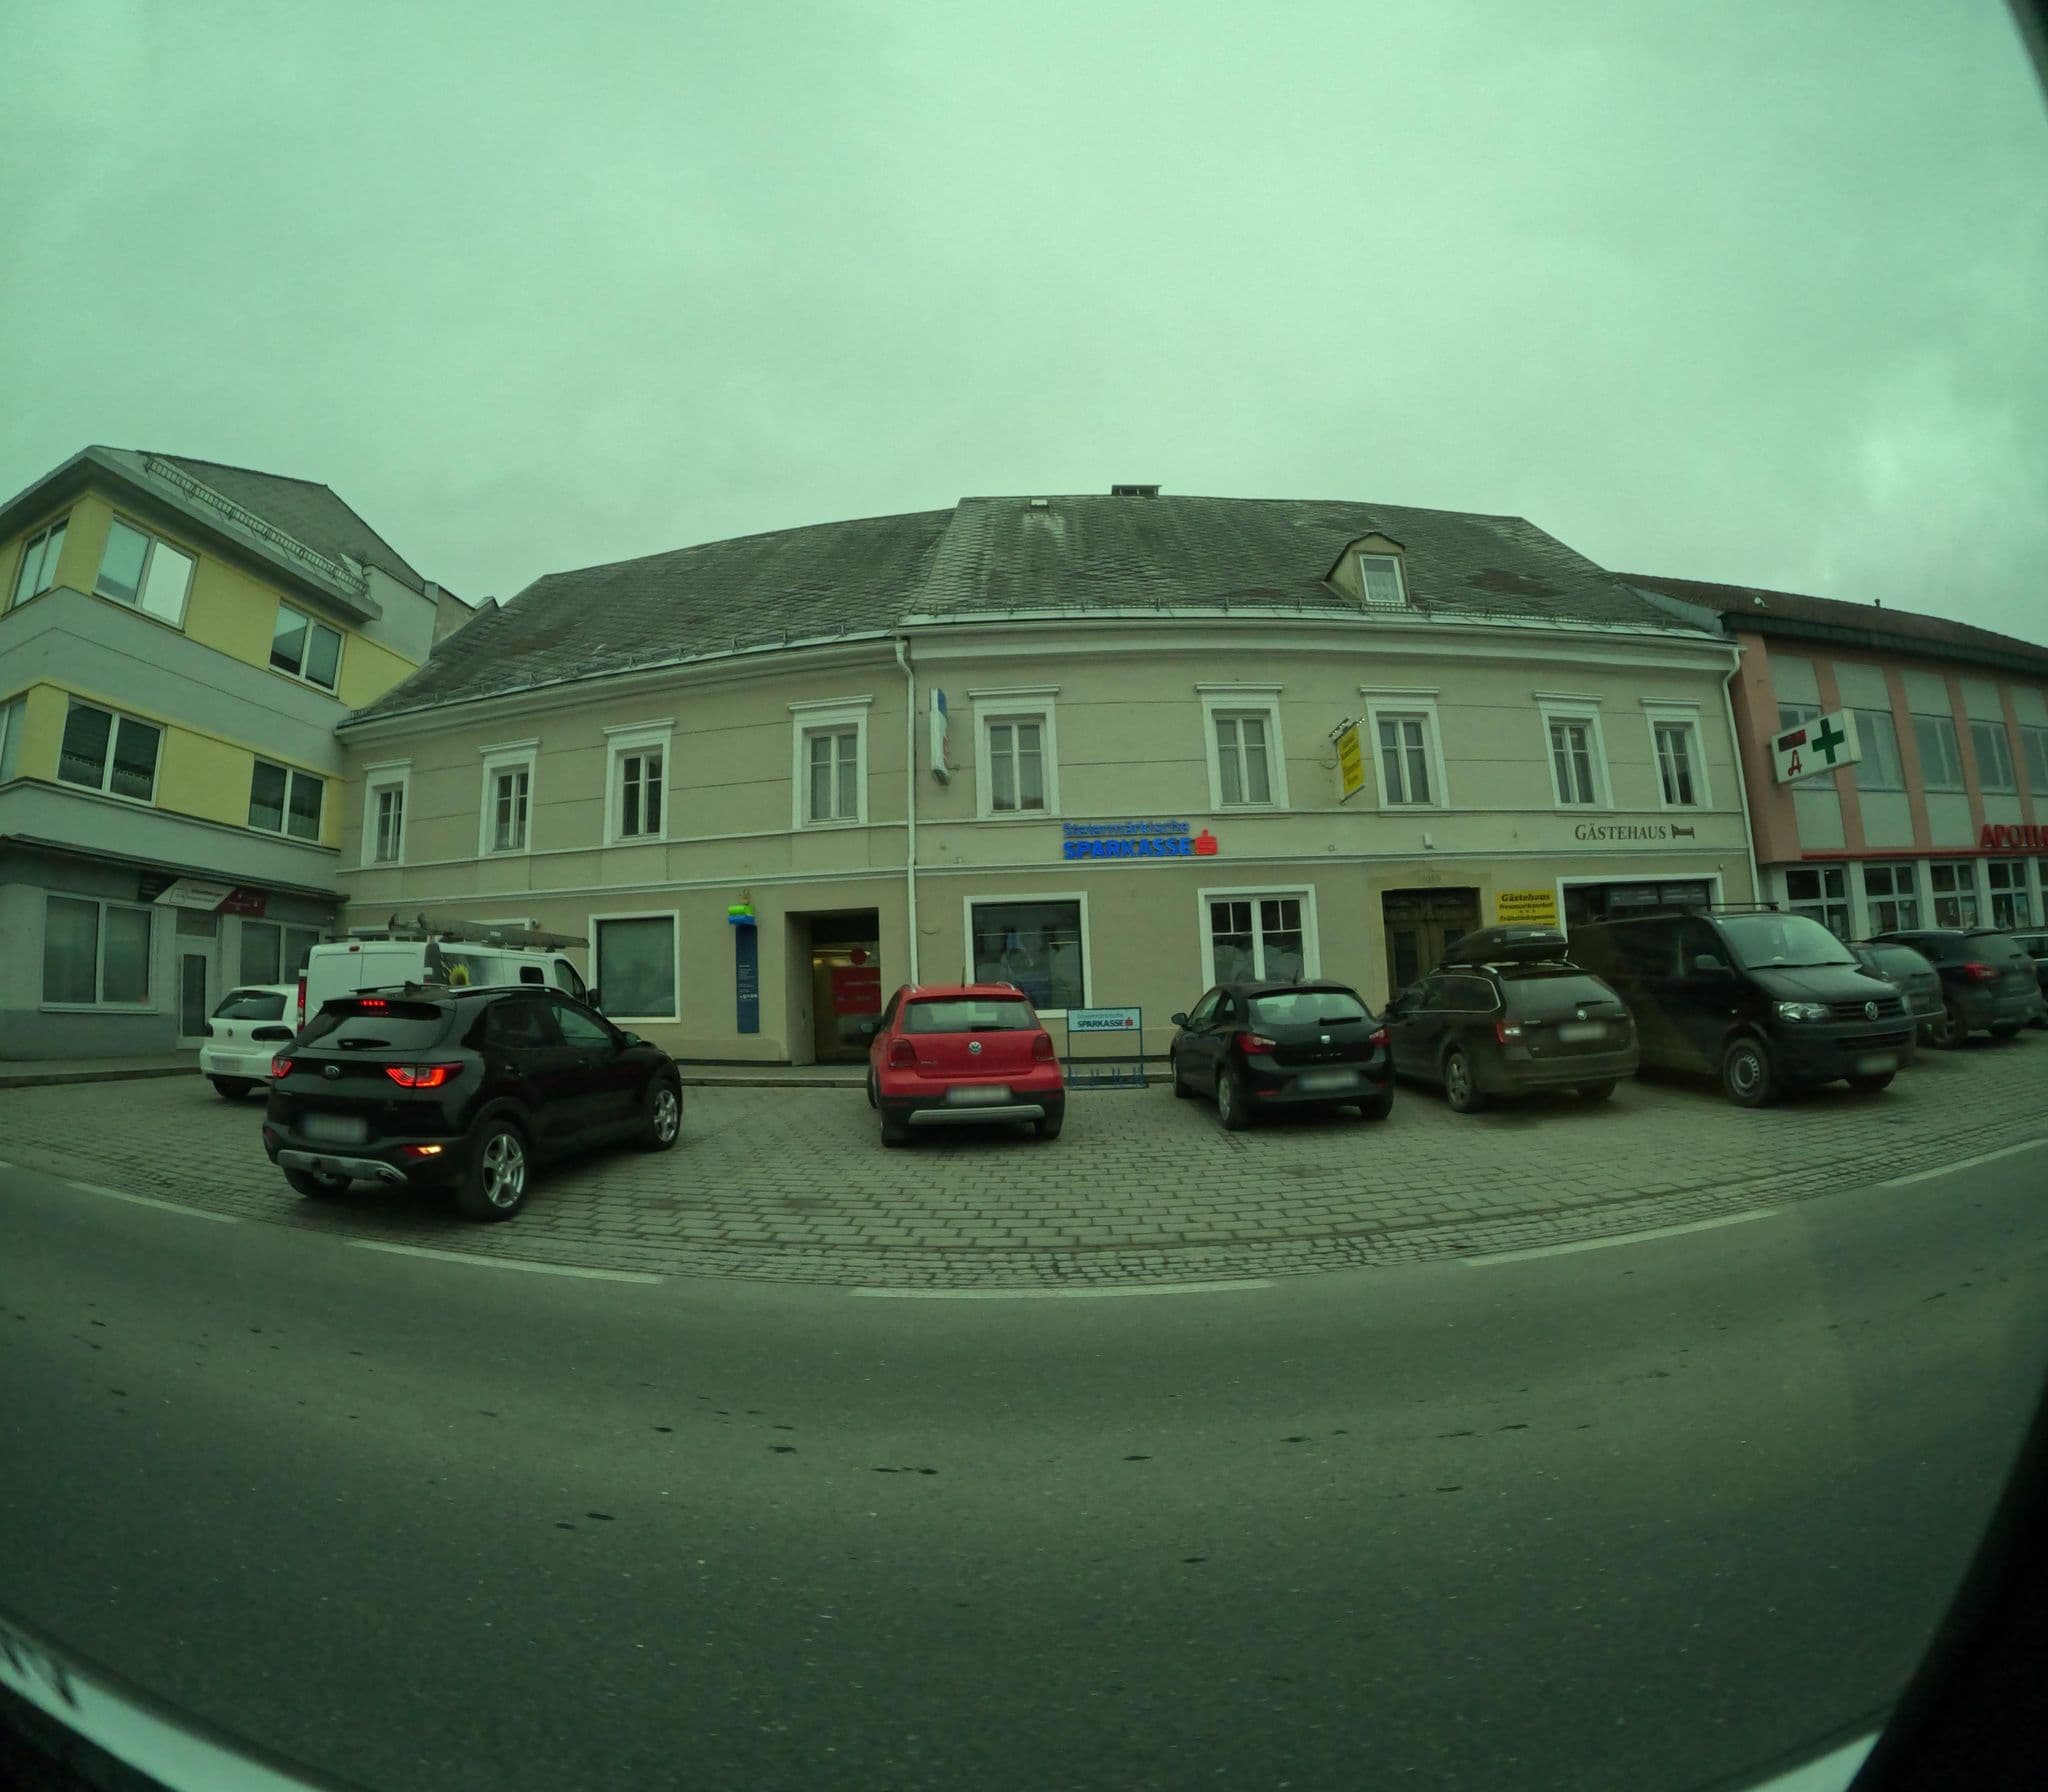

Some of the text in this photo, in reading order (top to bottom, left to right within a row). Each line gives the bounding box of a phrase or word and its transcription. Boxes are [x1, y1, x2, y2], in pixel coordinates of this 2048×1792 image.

[1788, 750, 1802, 776] A
[1575, 824, 1667, 840] GÄSTEHAUS
[1063, 838, 1192, 860] SPARKASSE
